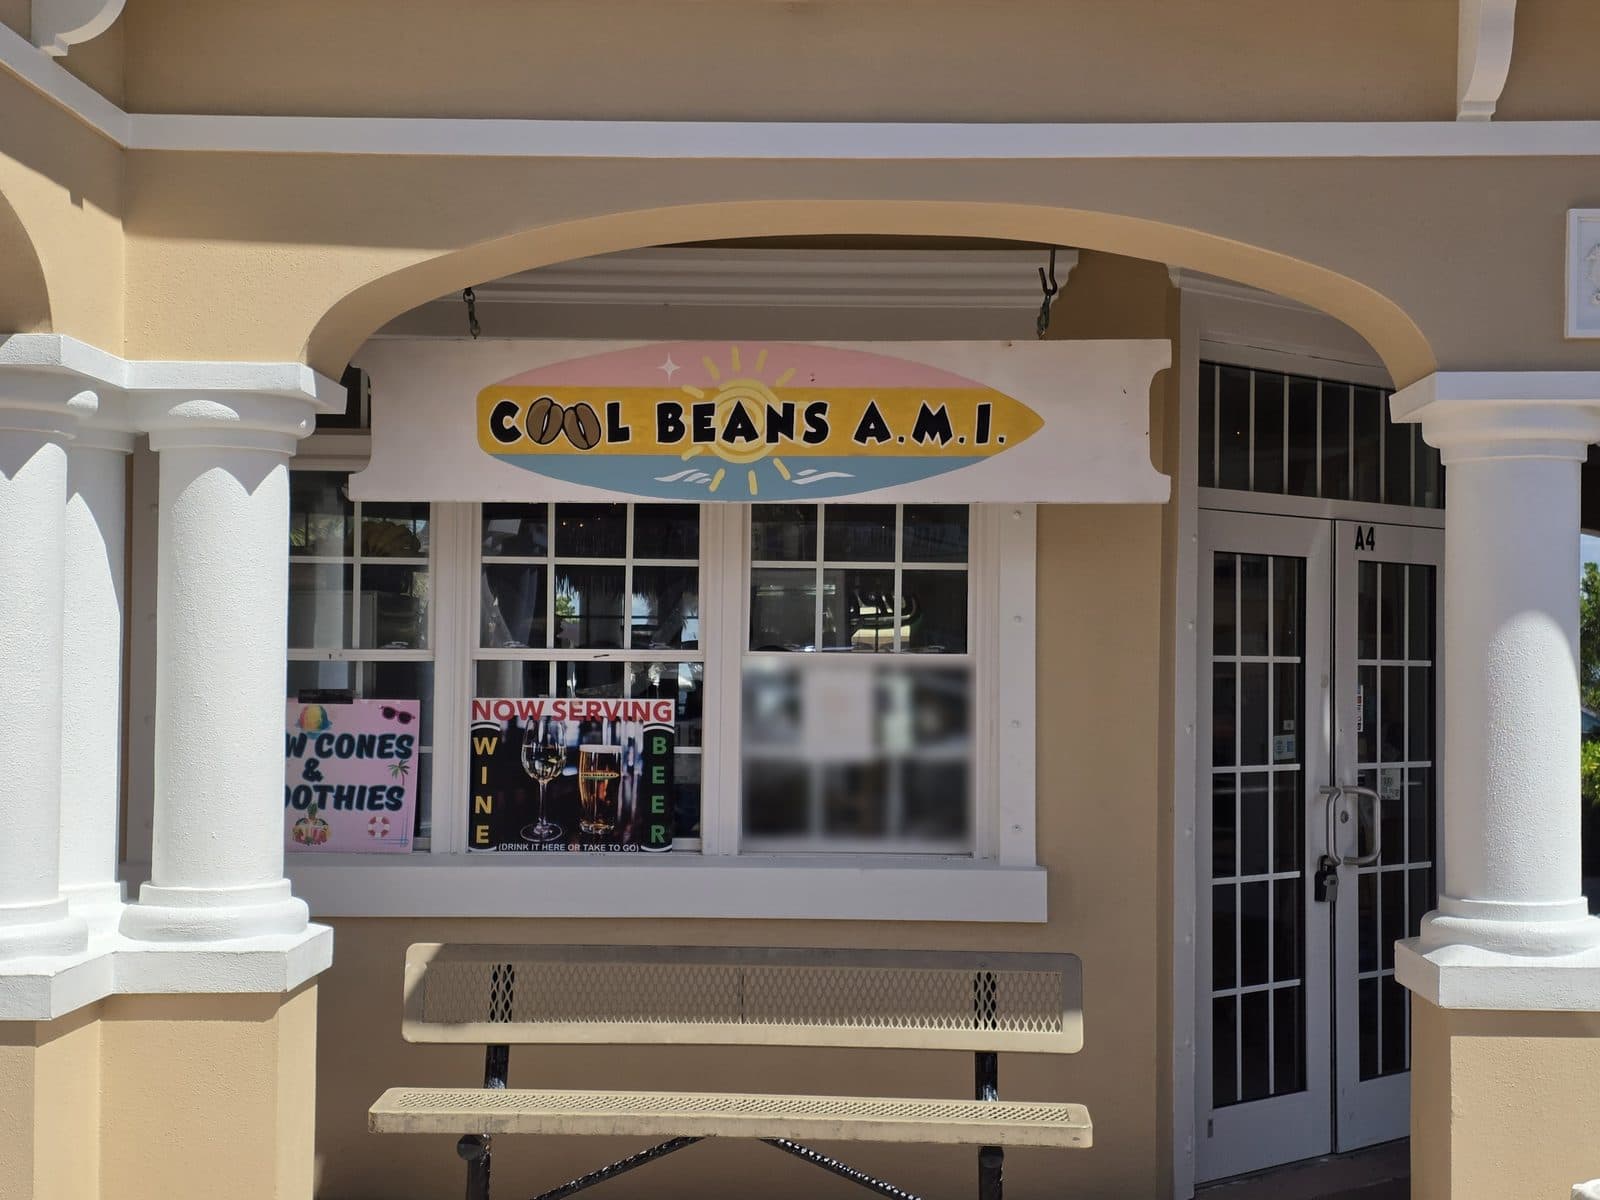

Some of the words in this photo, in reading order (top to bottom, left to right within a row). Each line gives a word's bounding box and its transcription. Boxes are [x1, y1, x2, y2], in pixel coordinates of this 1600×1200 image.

[488, 397, 631, 450] COOL
[656, 400, 830, 446] BEANS
[853, 400, 1007, 447] A.M.I.
[1354, 525, 1376, 551] A4
[471, 700, 545, 720] NOW
[551, 700, 672, 722] SERVING
[314, 733, 415, 759] CONES
[302, 758, 324, 782] &
[473, 737, 498, 844] WINE
[651, 736, 667, 844] BEER
[498, 843, 529, 852] (DRINK
[531, 843, 539, 852] IT
[541, 843, 566, 852] HERE
[567, 843, 580, 852] OR
[584, 844, 606, 852] TAKE
[609, 844, 620, 852] TO
[622, 844, 639, 853] GO)
